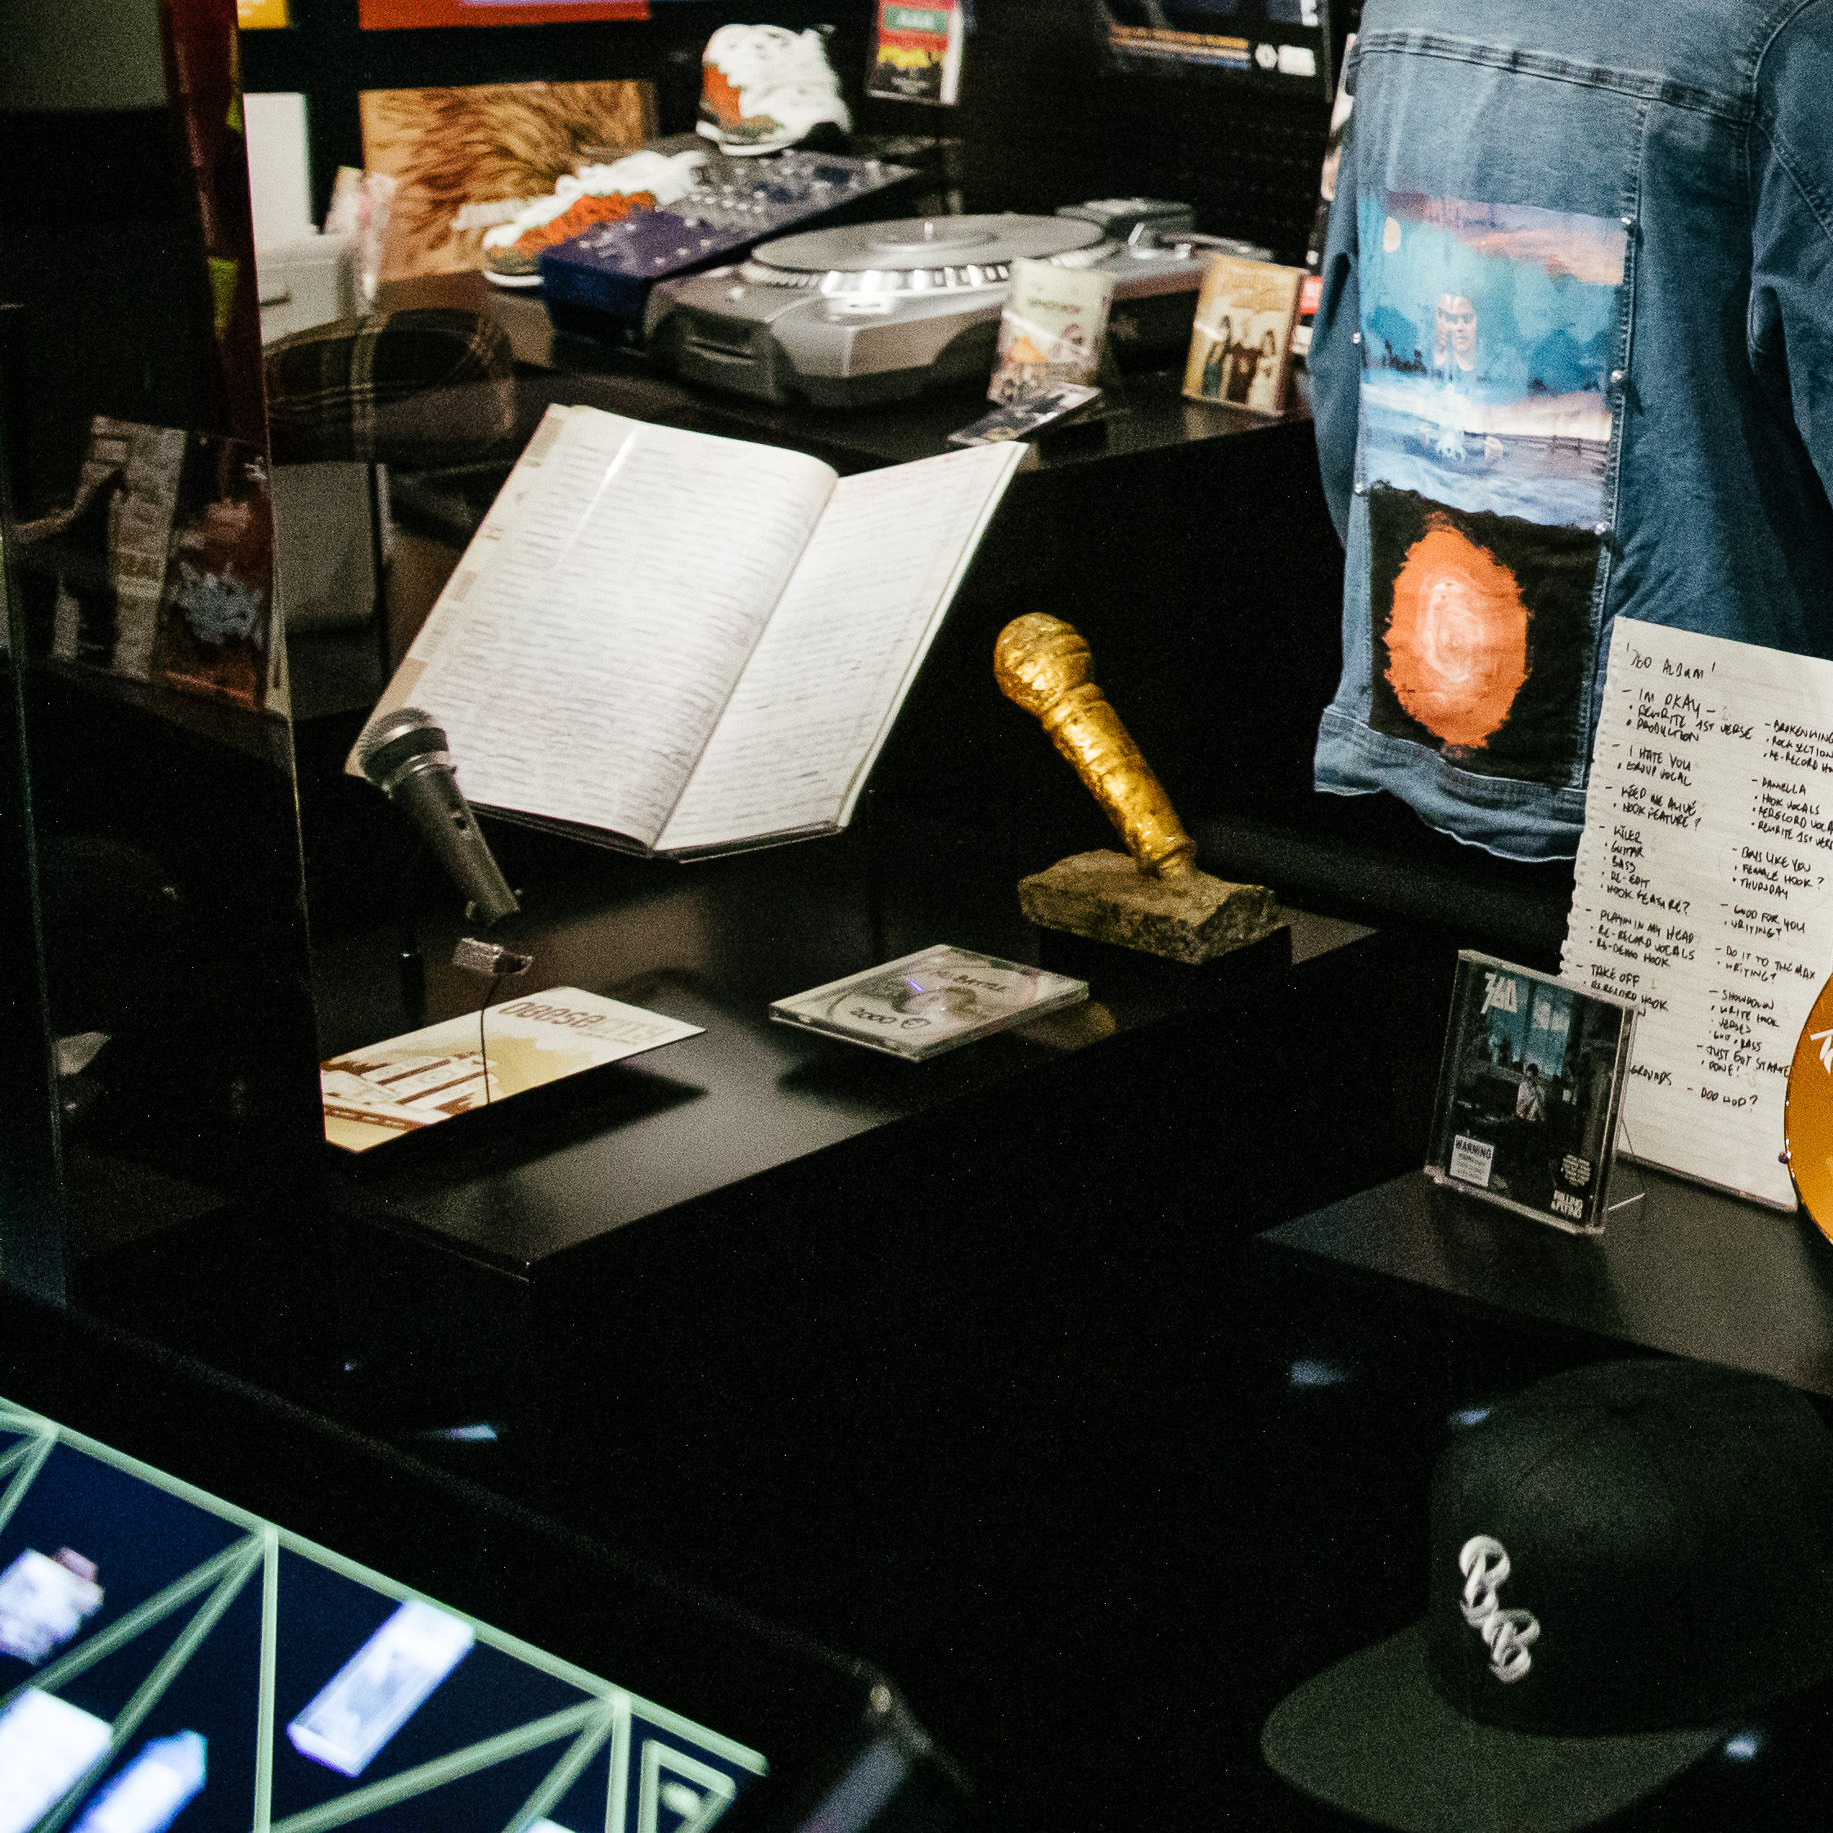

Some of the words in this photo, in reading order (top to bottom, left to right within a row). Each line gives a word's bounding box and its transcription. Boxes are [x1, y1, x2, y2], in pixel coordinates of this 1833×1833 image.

[1666, 926, 1694, 944] HEAD
[1591, 964, 1616, 980] TAKE
[1619, 972, 1640, 987] OFF
[1755, 1057, 1791, 1078] STARTE
[1455, 1137, 1493, 1160] WARNING
